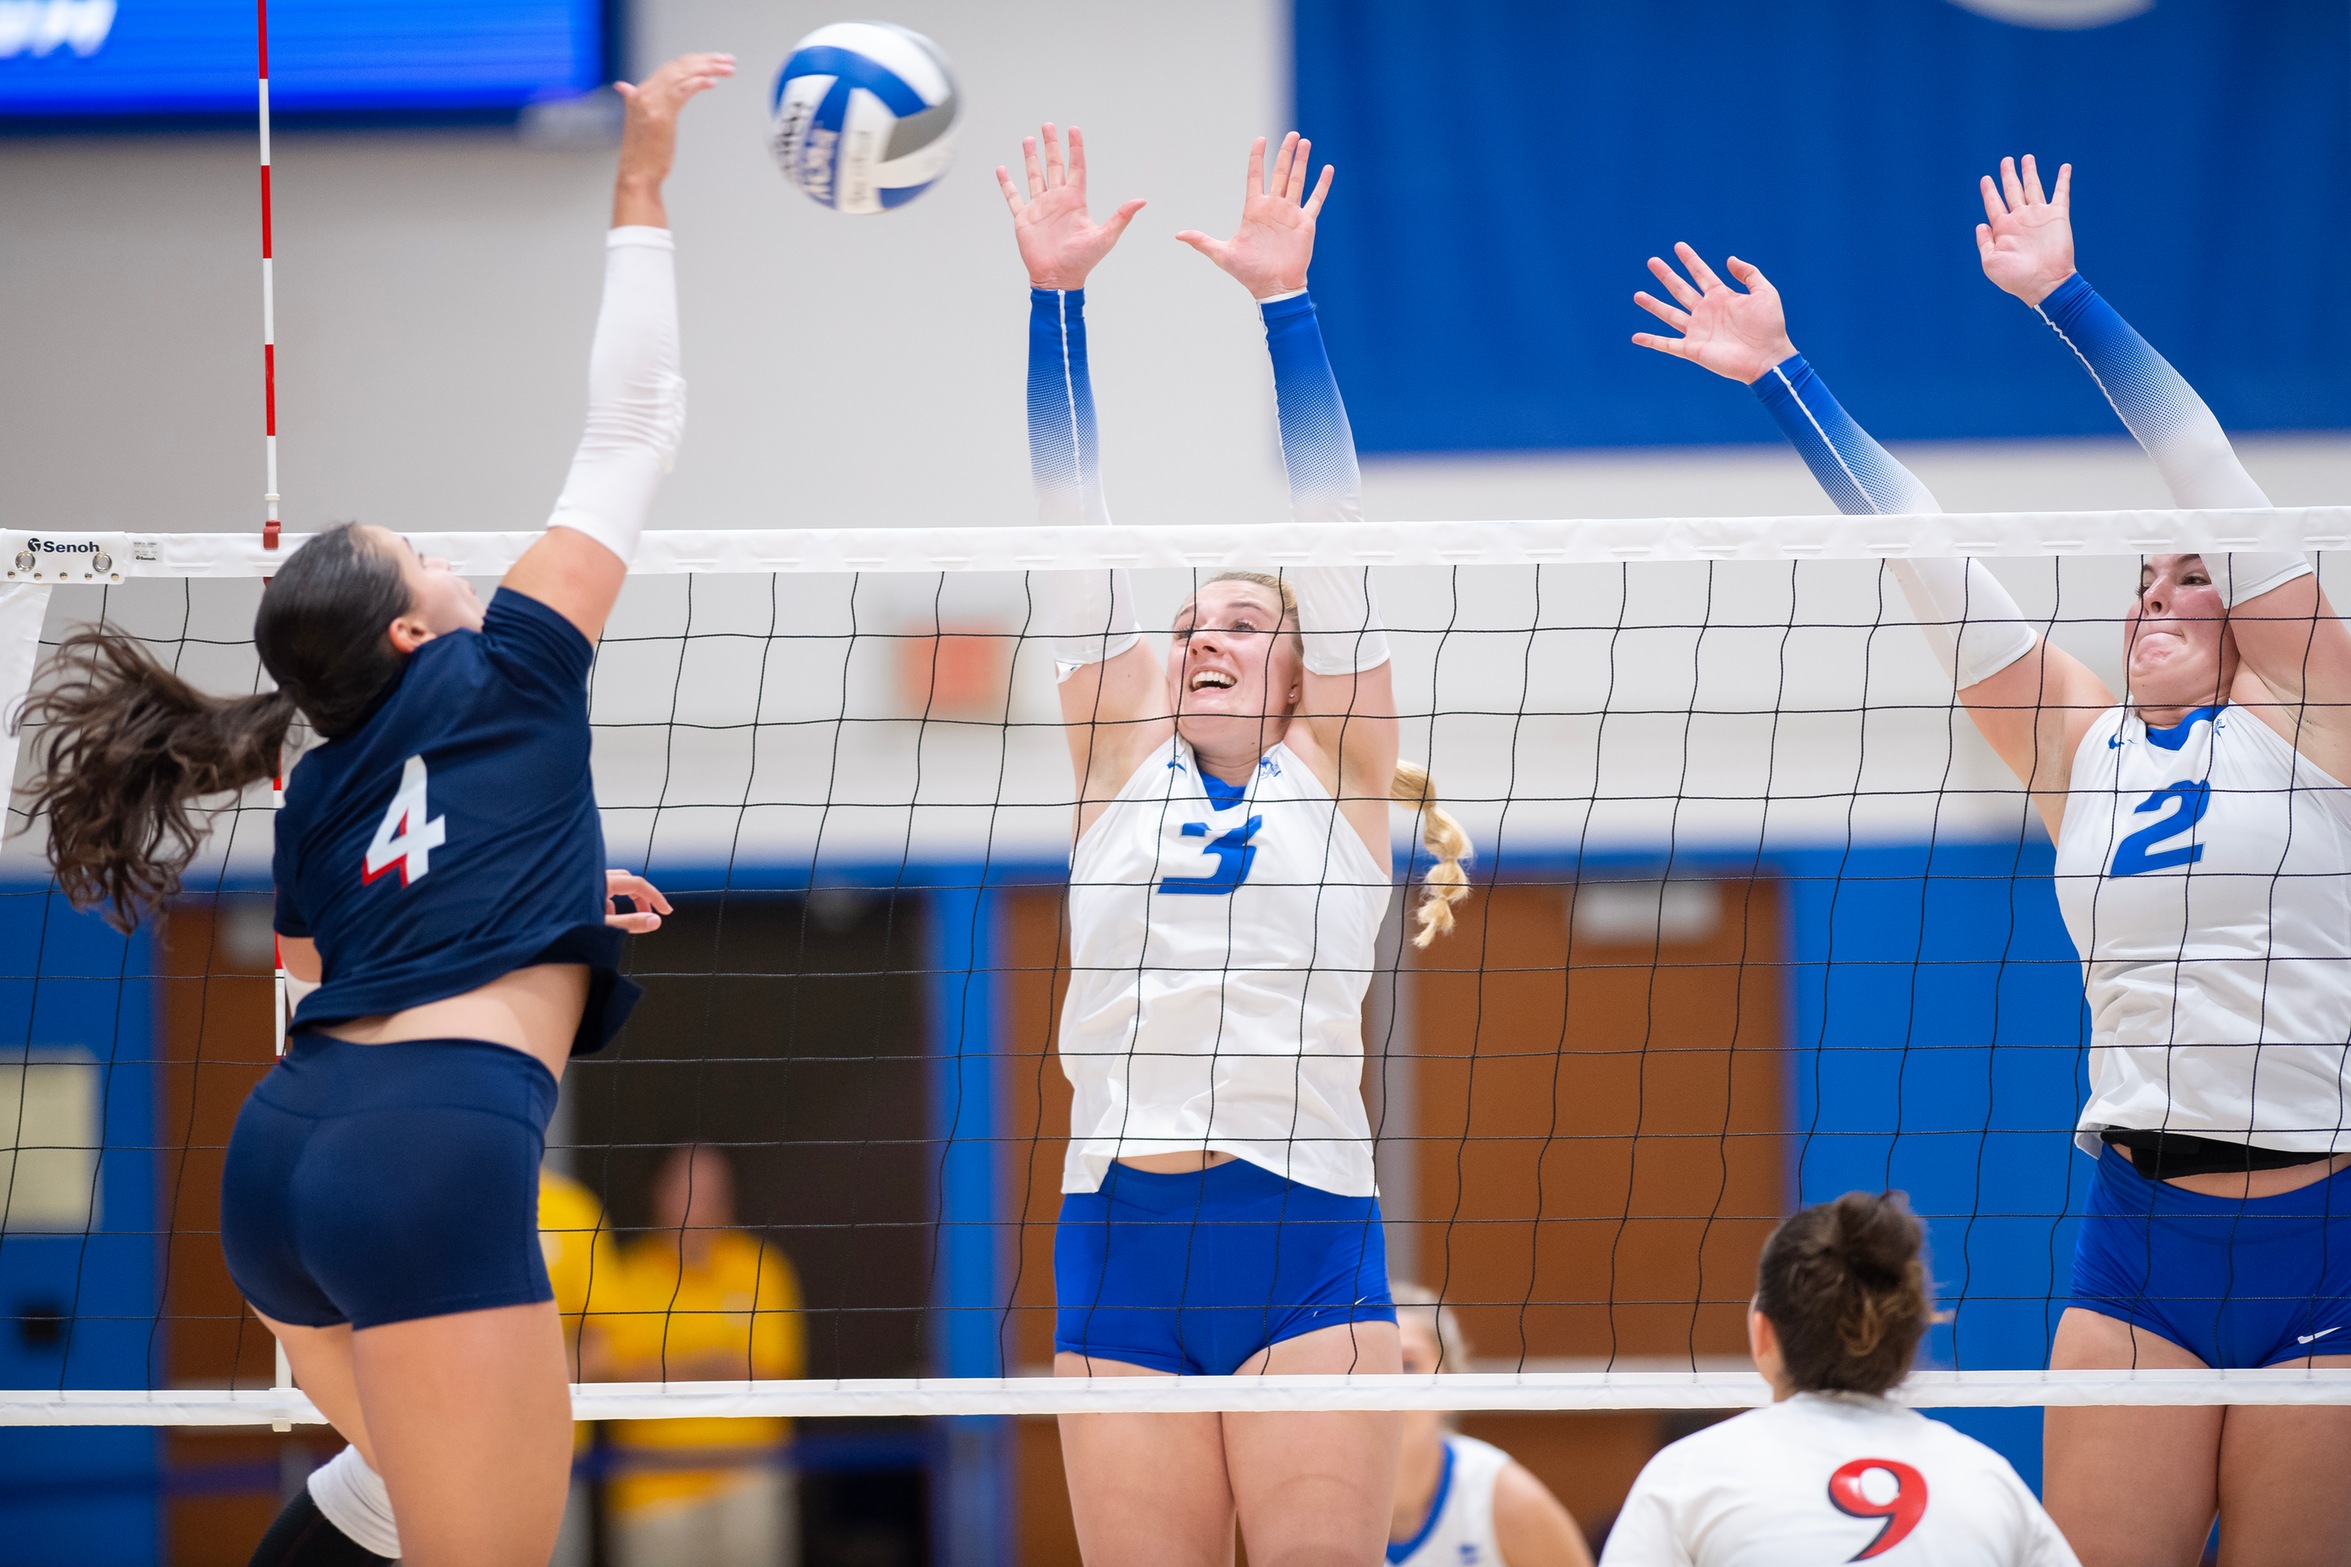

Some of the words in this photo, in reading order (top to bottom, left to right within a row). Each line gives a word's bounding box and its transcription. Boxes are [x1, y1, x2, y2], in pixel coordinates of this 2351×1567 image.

[43, 541, 100, 553] Senoh
[362, 753, 446, 889] 4
[1156, 814, 1262, 896] 3
[2108, 779, 2211, 881] 2
[1828, 1458, 1928, 1563] 9
